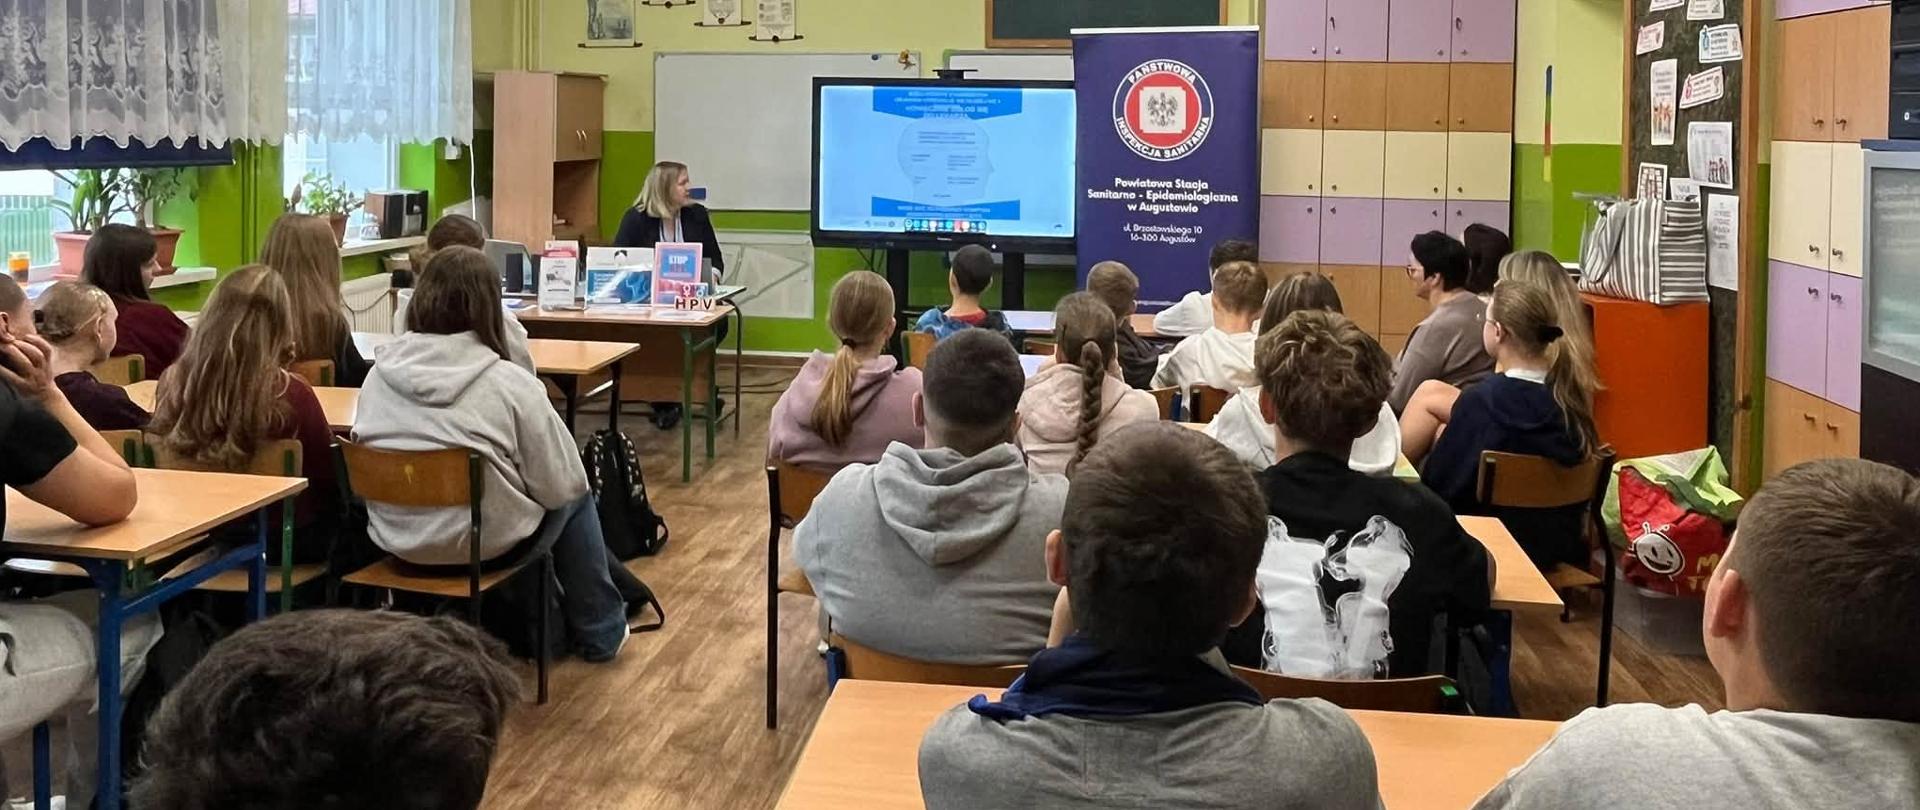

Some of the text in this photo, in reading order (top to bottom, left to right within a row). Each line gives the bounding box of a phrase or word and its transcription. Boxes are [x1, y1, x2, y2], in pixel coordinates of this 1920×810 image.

[1128, 62, 1196, 84] PAŃSTWOWA
[1116, 117, 1210, 159] INSPEKCJA SANITARNA
[1114, 177, 1209, 192] Powiatowa Stacja
[1087, 189, 1136, 199] Sanitarno
[1146, 190, 1239, 205] Epidemiologiczna
[1127, 202, 1199, 215] w Augustowie
[1194, 226, 1203, 234] 10
[676, 298, 712, 310] HPV
